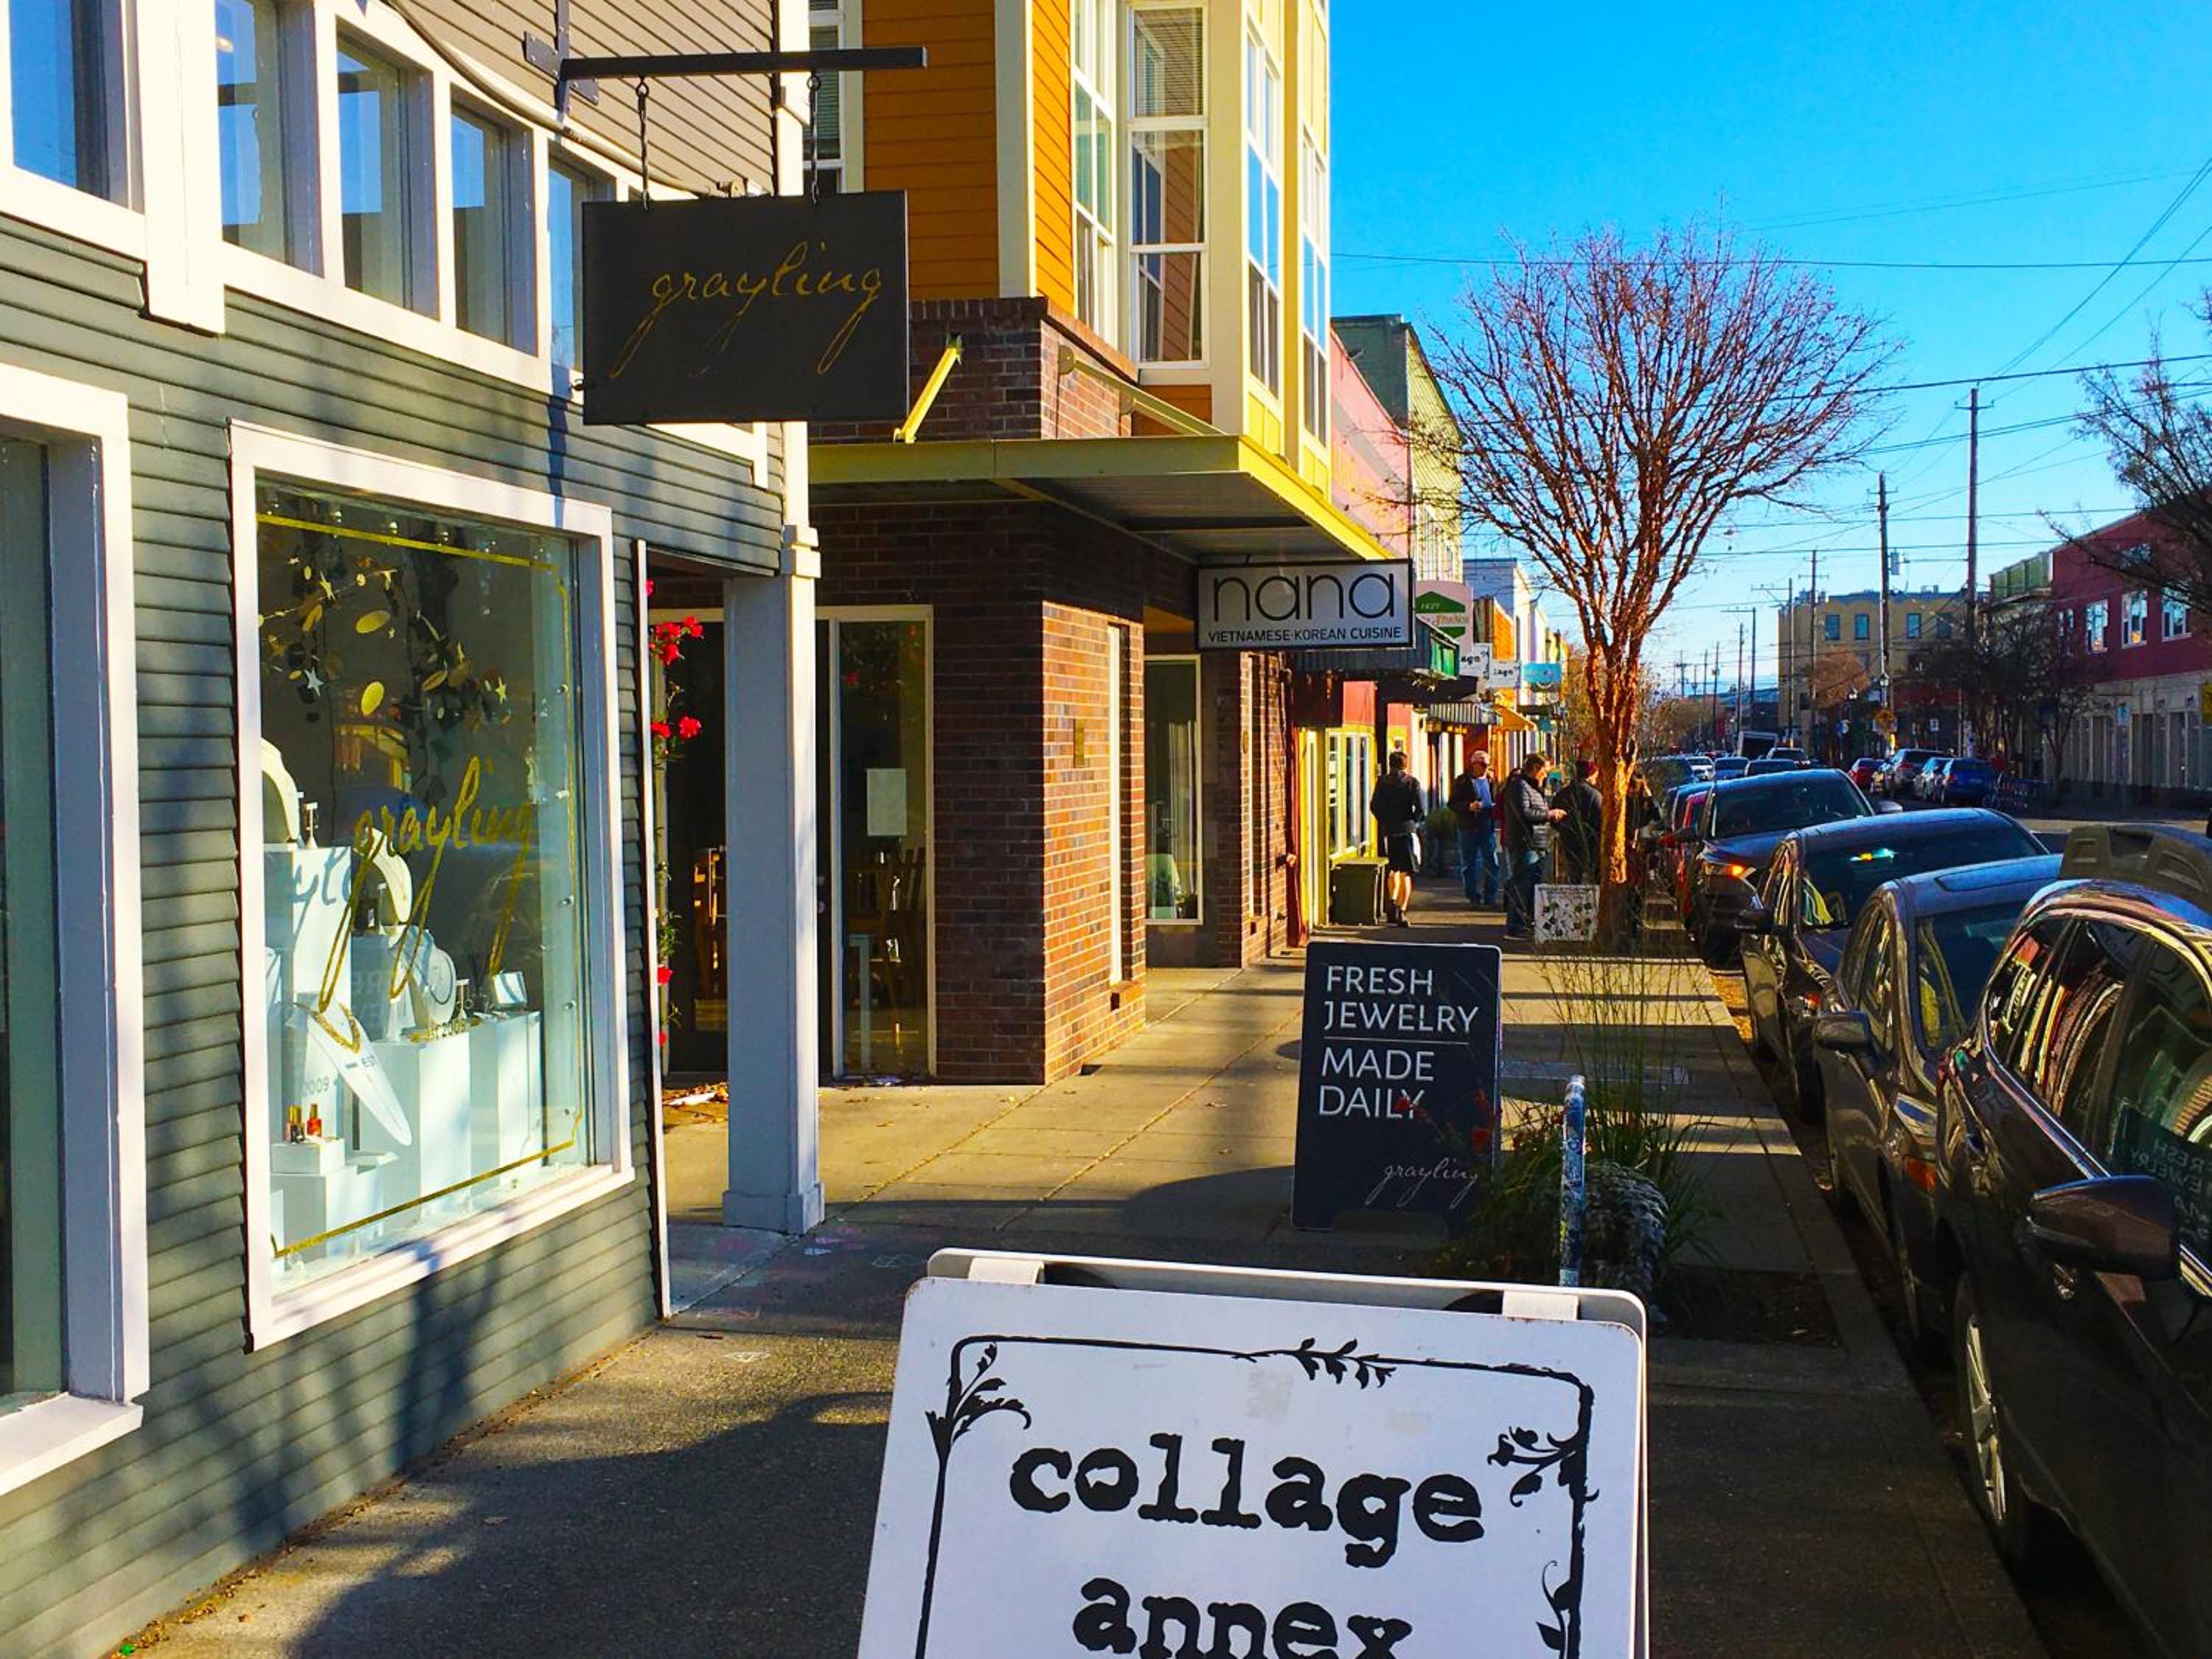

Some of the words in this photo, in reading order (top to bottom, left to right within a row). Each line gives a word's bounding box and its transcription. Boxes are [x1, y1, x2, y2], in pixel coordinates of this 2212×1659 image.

[609, 240, 883, 378] grayling
[1213, 573, 1394, 622] nana
[1350, 626, 1402, 640] CUISINE
[318, 755, 532, 1013] grayling
[1326, 965, 1434, 997] FRESH
[1324, 1001, 1479, 1033] JEWELRY
[1321, 1047, 1435, 1082] MADE
[1318, 1085, 1426, 1119] DAILY
[1009, 1431, 1485, 1569] collage
[1072, 1576, 1413, 1659] annex
